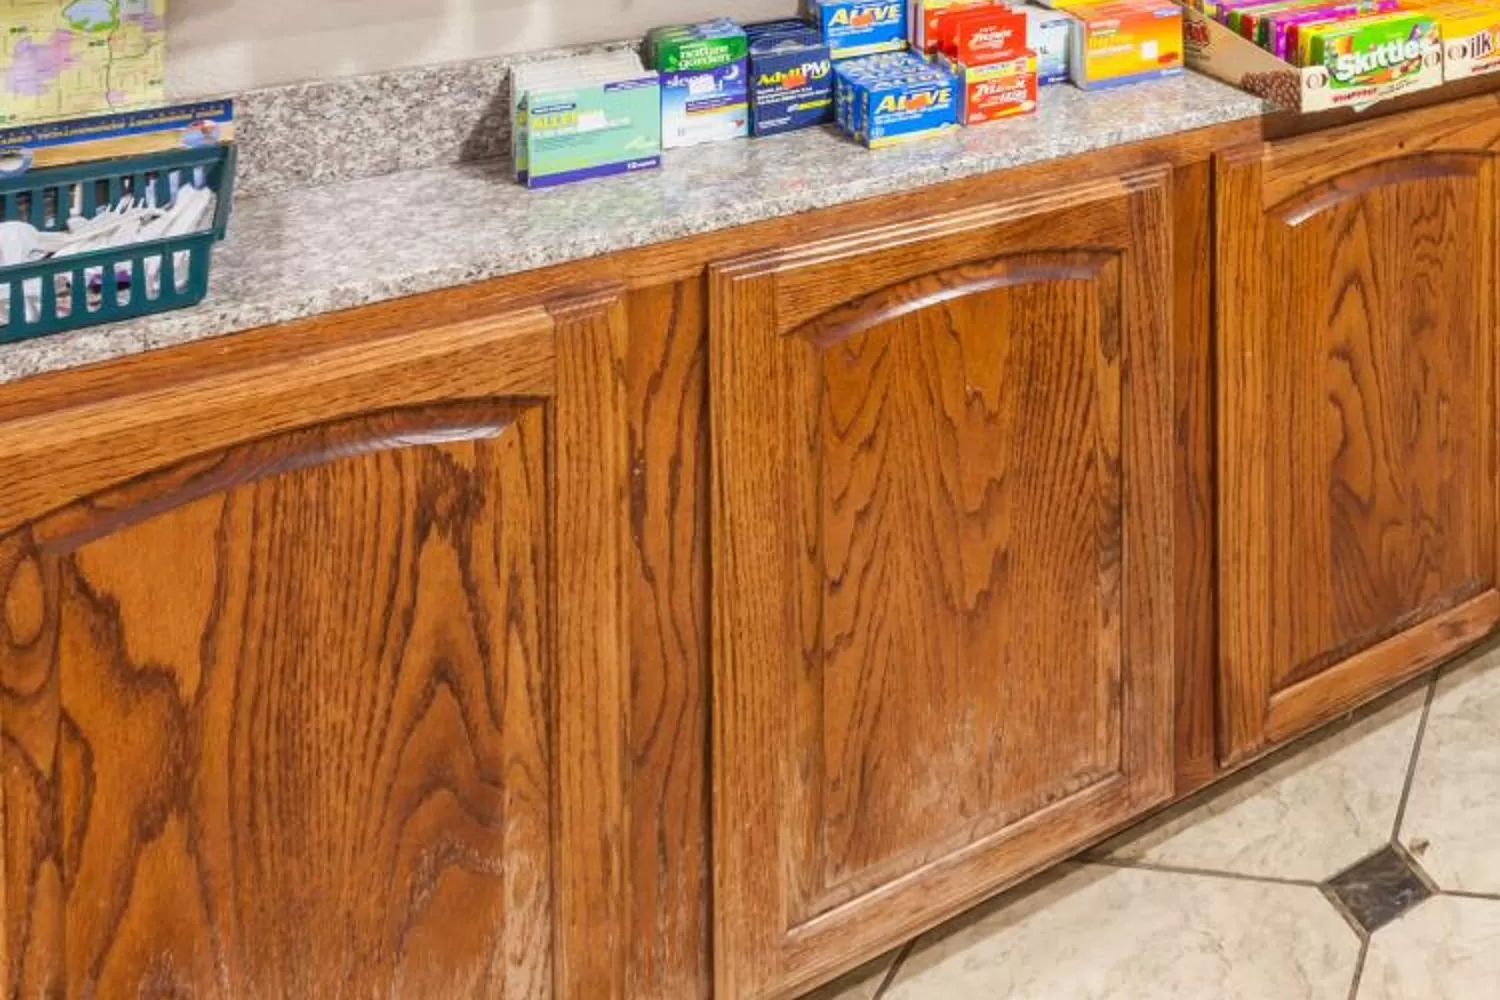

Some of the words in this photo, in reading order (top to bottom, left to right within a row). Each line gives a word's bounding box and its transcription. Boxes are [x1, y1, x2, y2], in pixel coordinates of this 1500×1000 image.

[828, 0, 902, 27] ALVE
[1334, 36, 1438, 82] Skittles
[1470, 31, 1494, 61] ilk
[874, 88, 953, 115] ALVE
